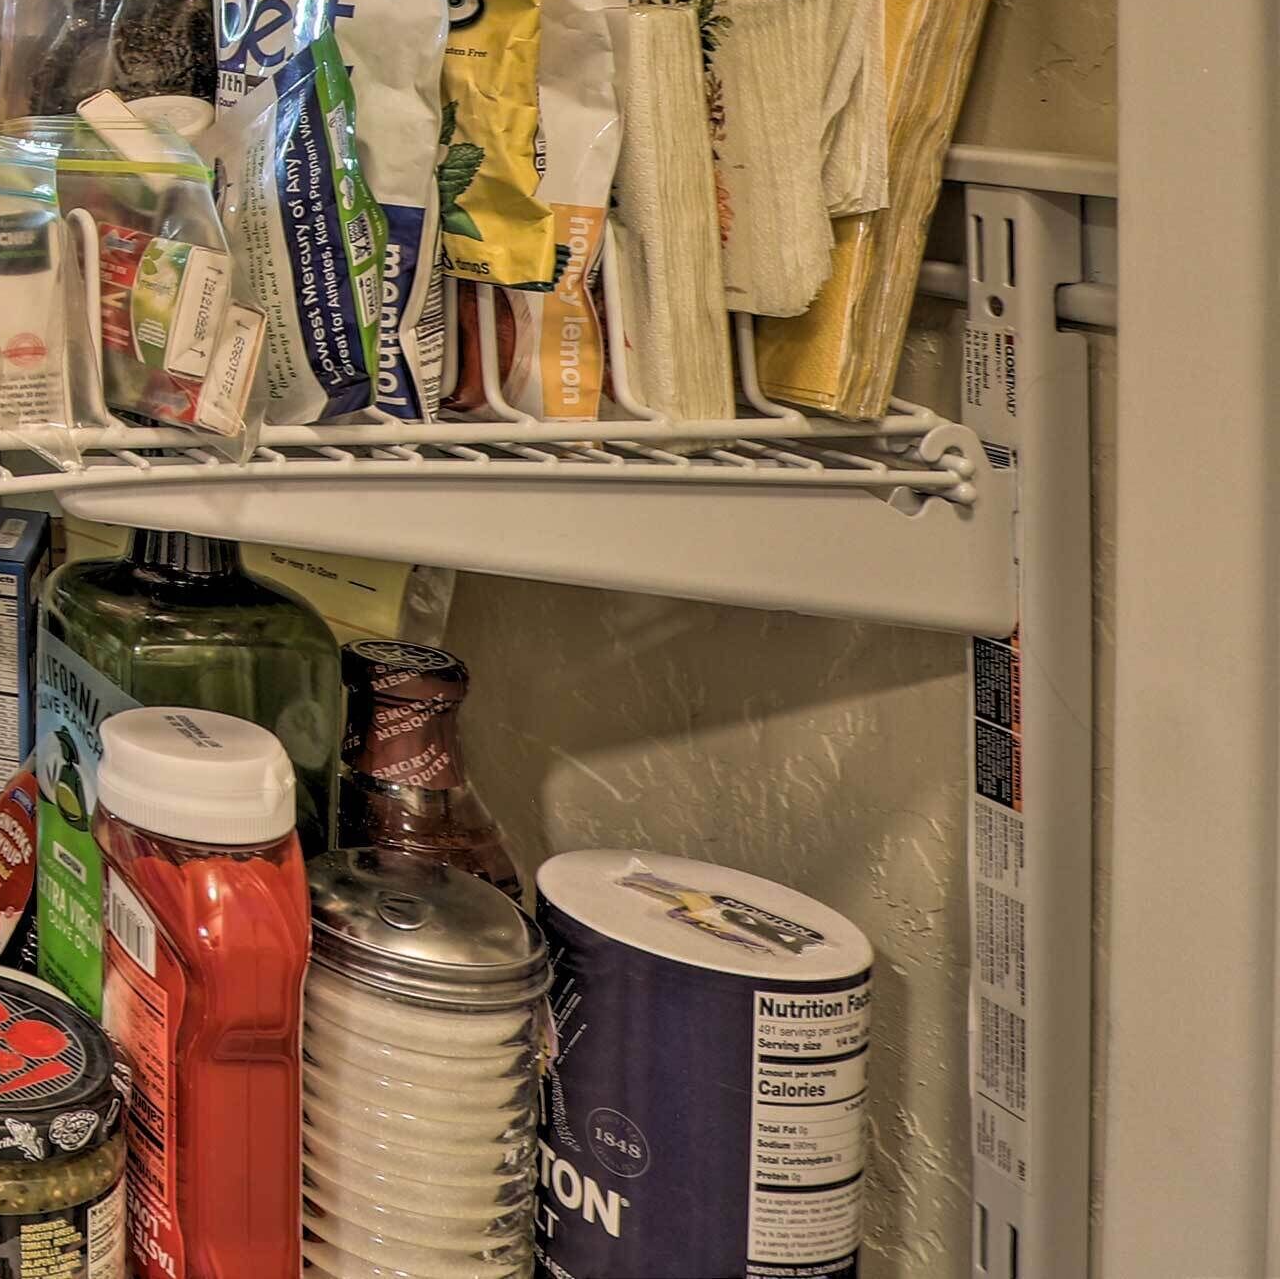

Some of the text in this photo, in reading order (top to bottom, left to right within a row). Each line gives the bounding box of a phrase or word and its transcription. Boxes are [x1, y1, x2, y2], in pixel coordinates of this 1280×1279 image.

[307, 142, 322, 202] Pregnant
[312, 202, 324, 217] &
[317, 219, 332, 244] Kids
[286, 155, 341, 387] Lowest Mercury of Any
[322, 245, 342, 310] Athletes,
[332, 310, 344, 331] for
[555, 215, 593, 407] honey lemon
[376, 242, 409, 408] menthol
[338, 333, 356, 379] Great
[371, 743, 437, 780] SMOKEY
[759, 997, 843, 1019] Nutrition
[758, 1038, 823, 1053] Serving size
[758, 1079, 826, 1098] Calories
[758, 1123, 798, 1134] Total Fat
[593, 1126, 642, 1159] 1848
[757, 1139, 791, 1150] Sodium
[757, 1154, 780, 1165] Total
[756, 1170, 790, 1182] Protein
